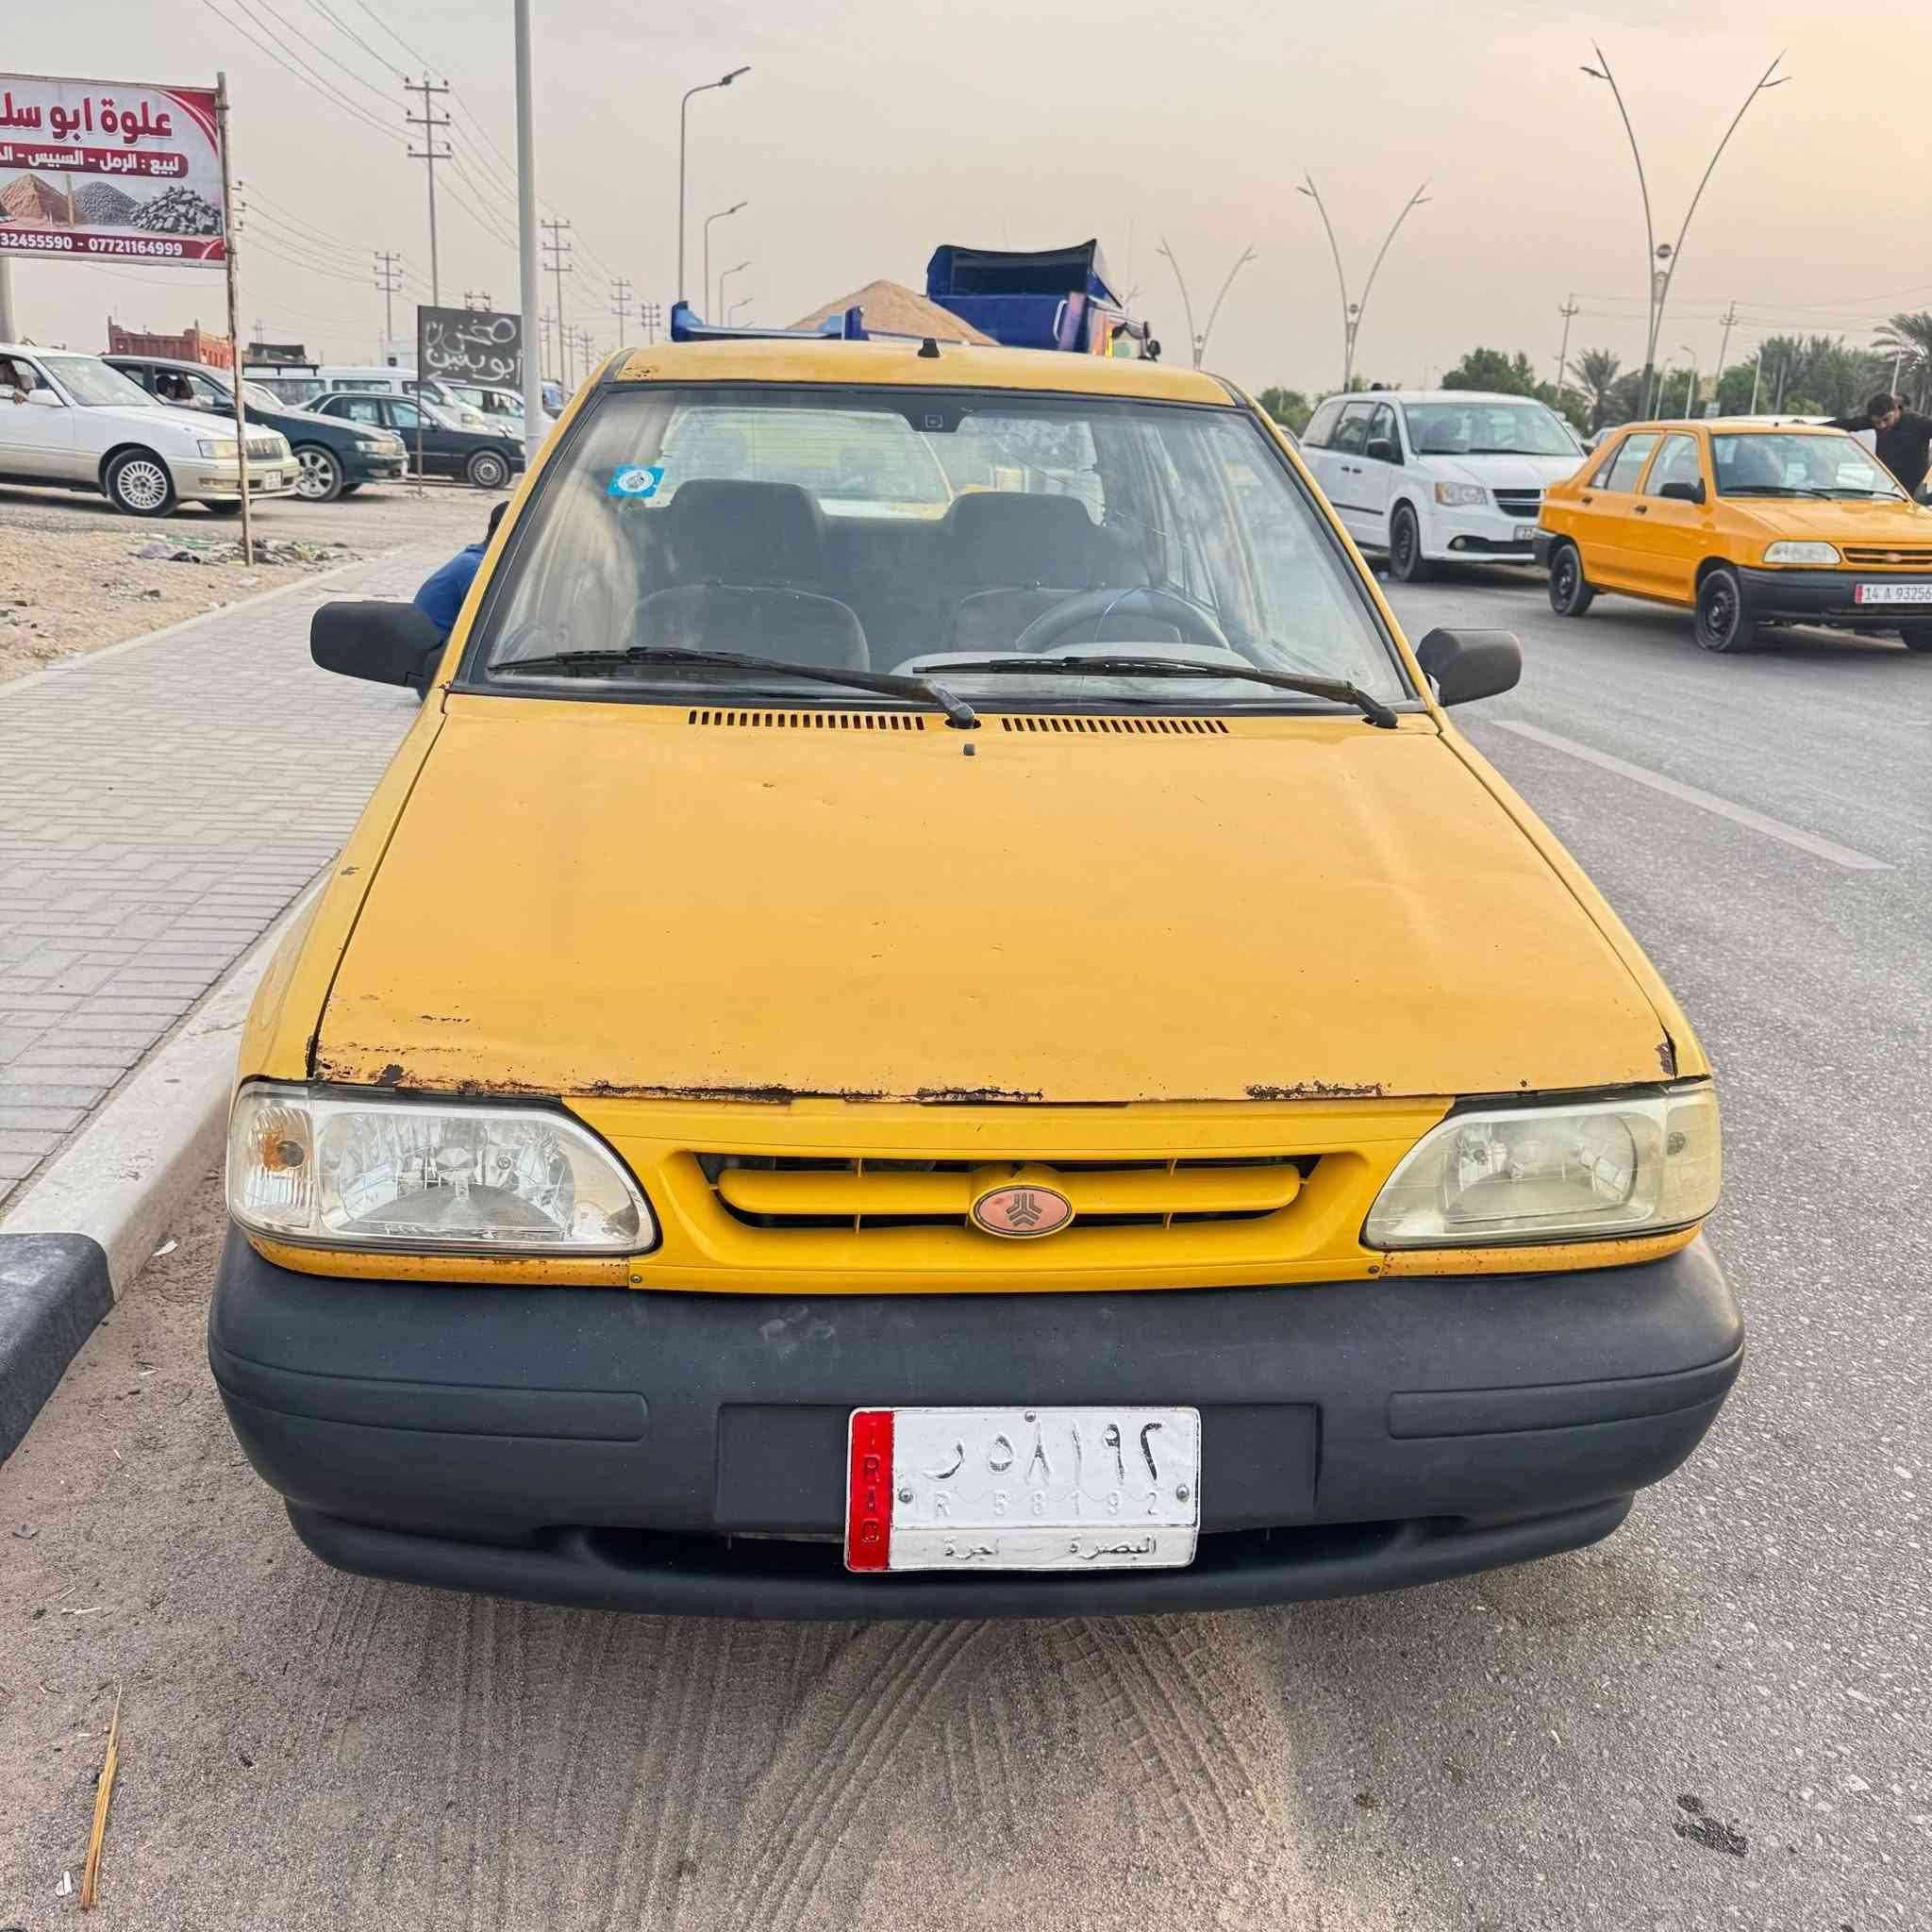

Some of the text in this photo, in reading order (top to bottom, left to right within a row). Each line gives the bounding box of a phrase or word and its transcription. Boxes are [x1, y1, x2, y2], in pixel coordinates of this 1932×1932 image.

[50, 97, 92, 142] ابو
[100, 98, 173, 144] علوة
[28, 150, 84, 168] السبيس
[100, 154, 137, 174] الرمل
[151, 157, 179, 174] لبيع
[89, 238, 183, 256] 07721164999
[861, 1422, 881, 1543] IRAQ
[1068, 1534, 1158, 1561] البصرة
